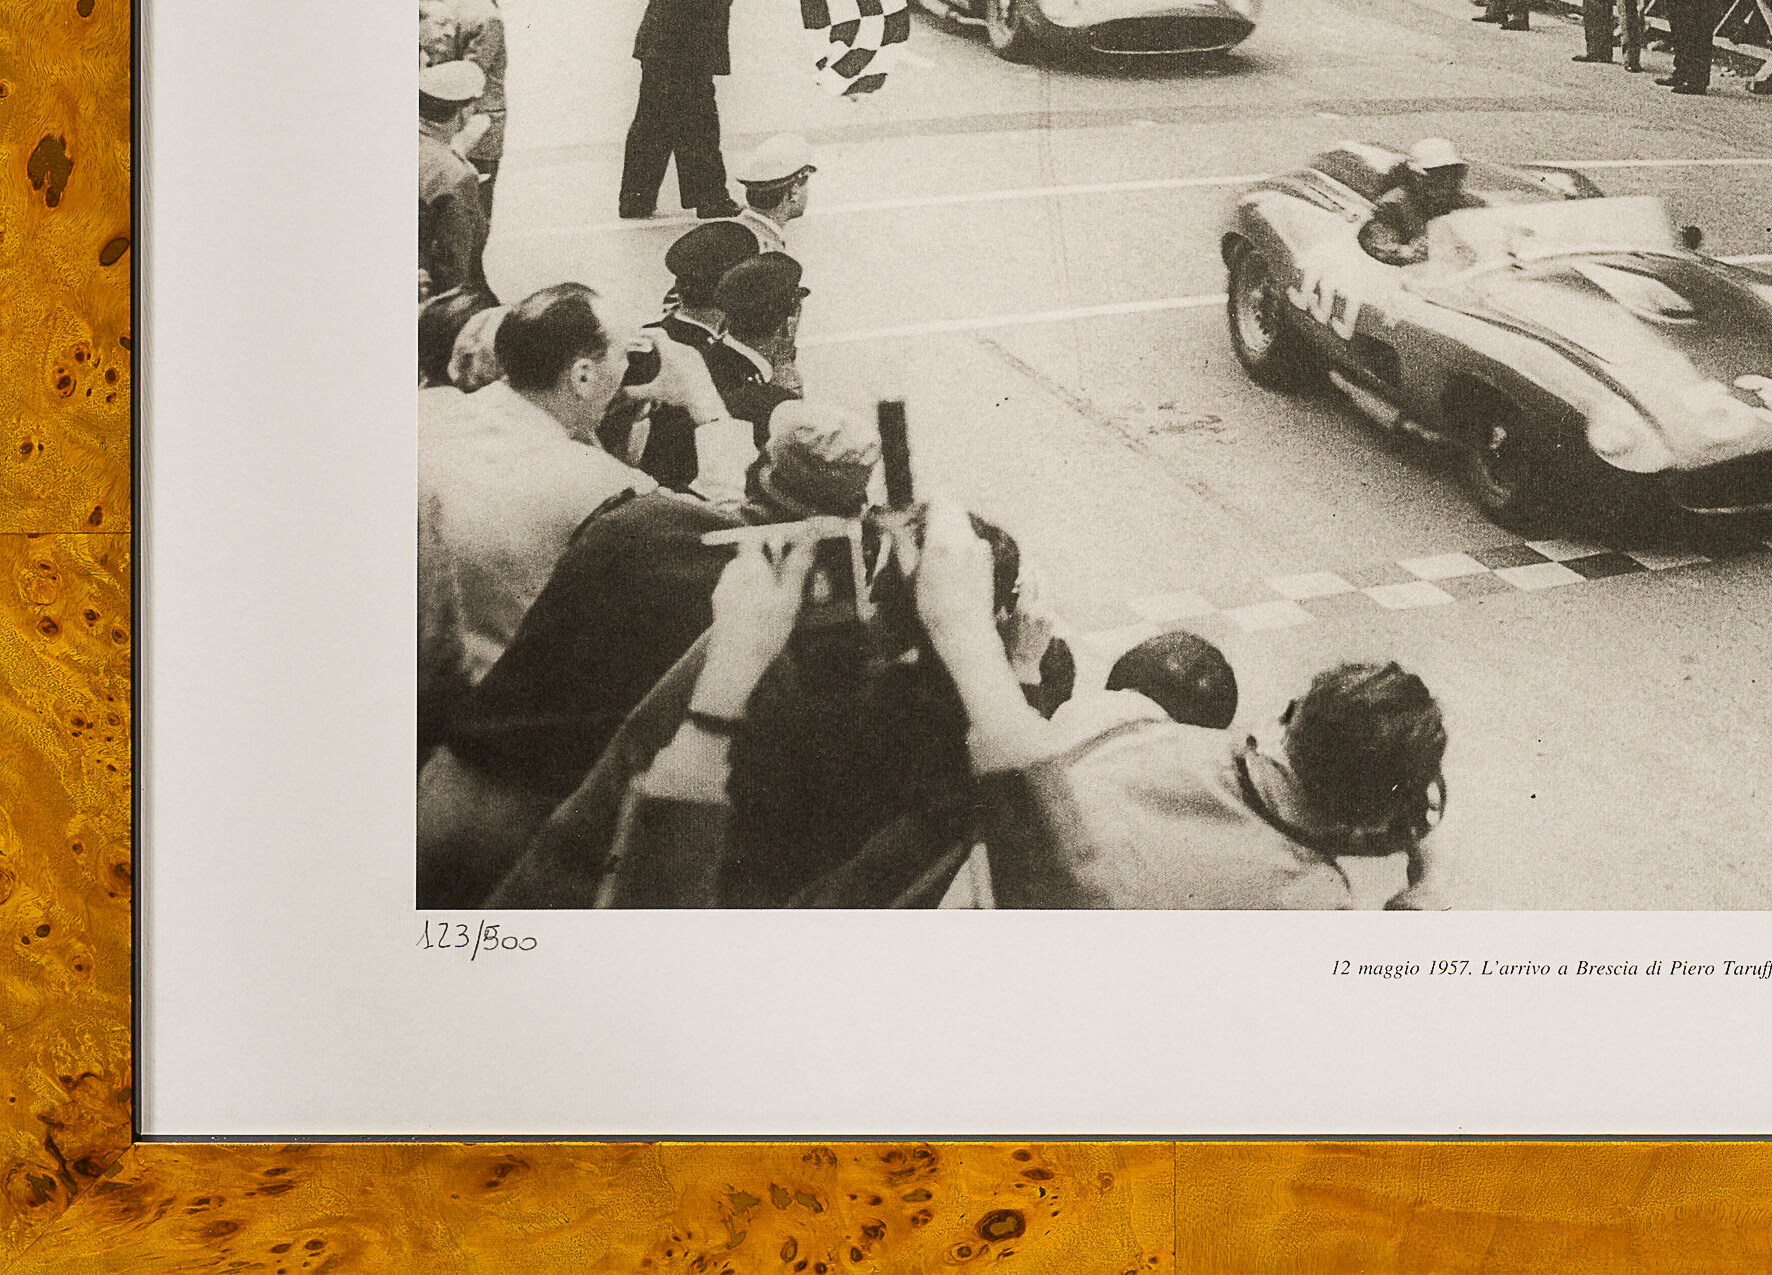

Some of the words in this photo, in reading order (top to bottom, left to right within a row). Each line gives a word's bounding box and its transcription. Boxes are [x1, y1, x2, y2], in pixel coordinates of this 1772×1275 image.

[1332, 959, 1351, 975] 12
[1358, 960, 1420, 980] maggio
[1429, 959, 1473, 976] 1957.
[1557, 965, 1568, 976] a
[1576, 960, 1638, 976] Brescia
[1645, 960, 1663, 976] di
[1669, 960, 1715, 976] Piero
